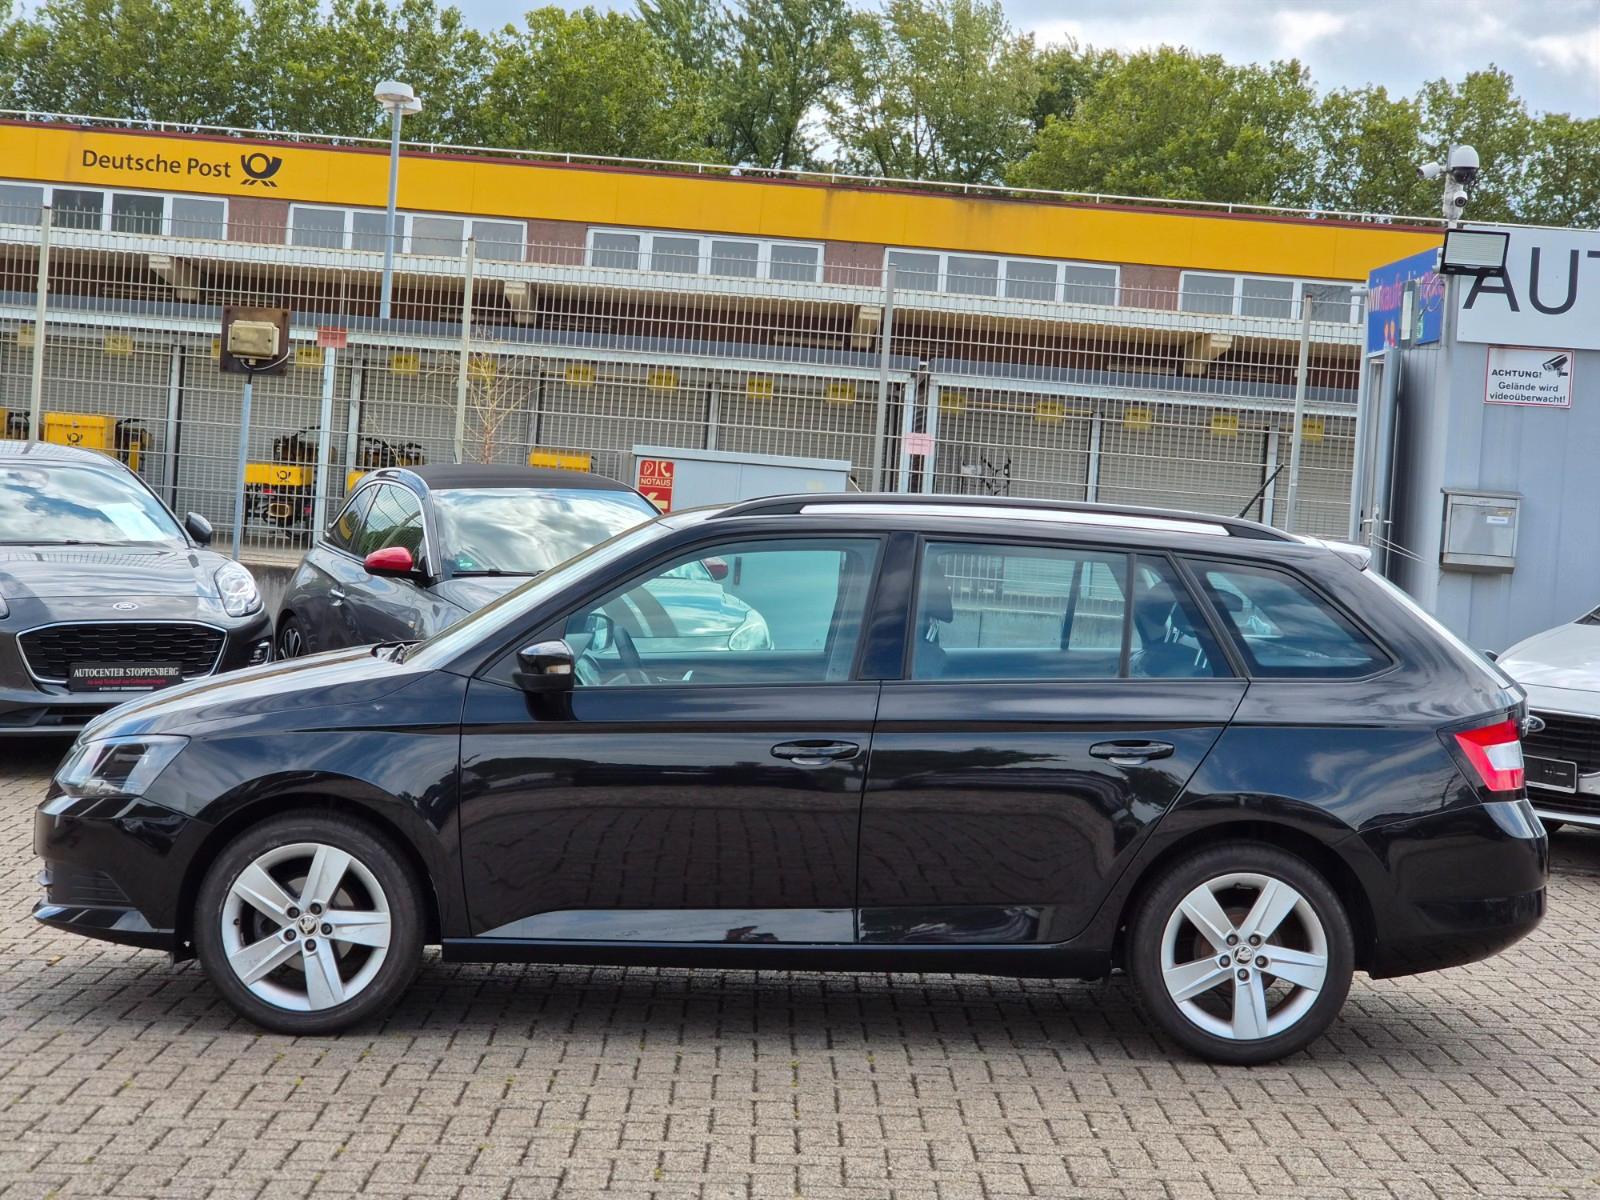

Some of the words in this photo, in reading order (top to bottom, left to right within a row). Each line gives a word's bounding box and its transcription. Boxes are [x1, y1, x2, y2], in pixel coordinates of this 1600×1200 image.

[82, 149, 181, 174] Deutsche
[187, 157, 231, 178] Post
[1463, 247, 1600, 315] AU
[1491, 369, 1542, 378] ACHTUNG!
[1498, 381, 1536, 391] Gelände
[1539, 384, 1559, 392] wird
[1490, 392, 1566, 403] videoüberwacht!
[640, 478, 671, 486] NOTAUS
[73, 667, 124, 678] AUTOCENTER
[125, 667, 179, 677] STOPPENBERG
